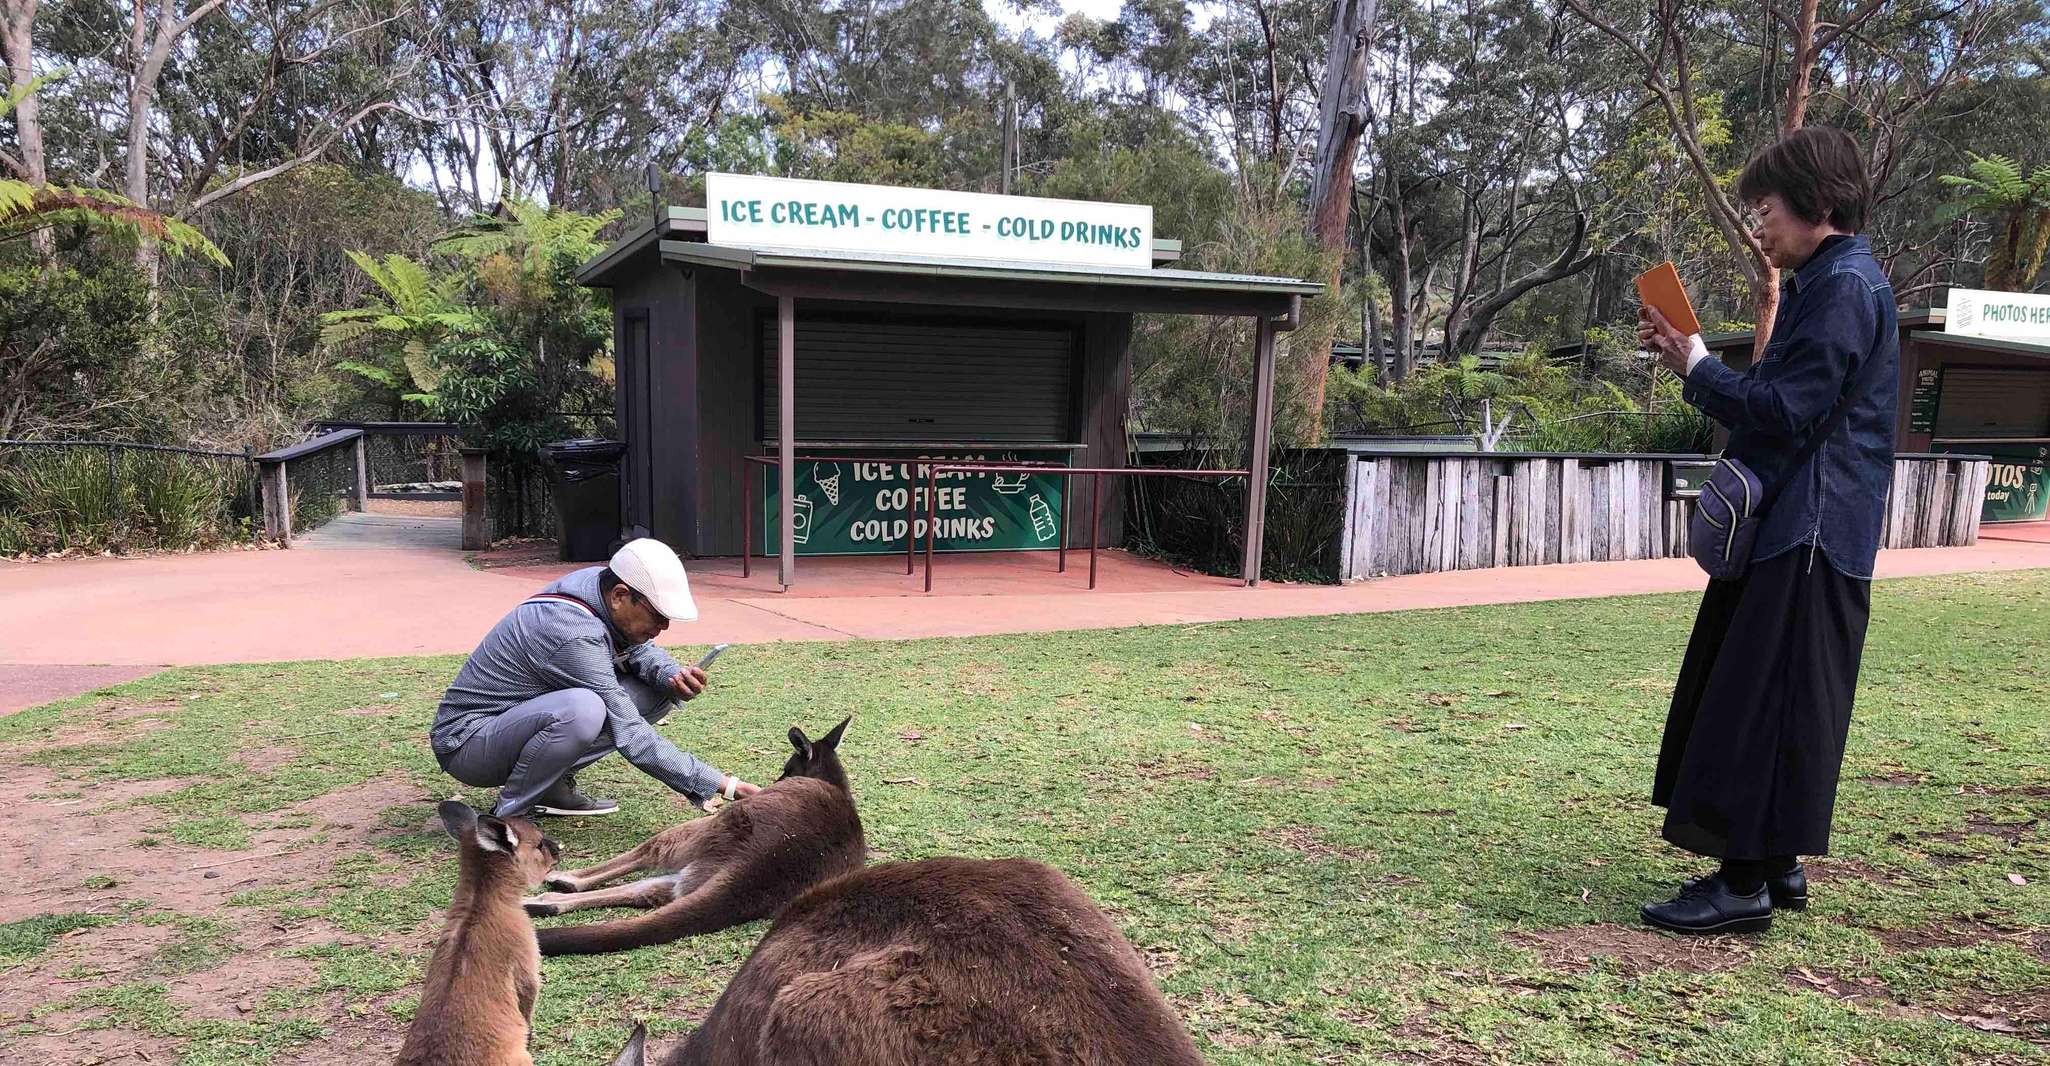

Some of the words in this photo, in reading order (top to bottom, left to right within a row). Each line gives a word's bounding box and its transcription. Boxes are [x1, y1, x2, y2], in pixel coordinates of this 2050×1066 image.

[720, 199, 764, 223] ICE
[770, 200, 860, 228] CREAM
[881, 208, 971, 234] COFFEE
[997, 216, 1054, 241] COLD
[1061, 221, 1142, 249] DRINKS
[1983, 303, 2027, 323] PHOTOS
[853, 461, 895, 481] ICE
[875, 487, 967, 512] COFFEE
[1987, 490, 2010, 503] today
[850, 519, 909, 542] COLD
[913, 516, 996, 540] DRINKS
